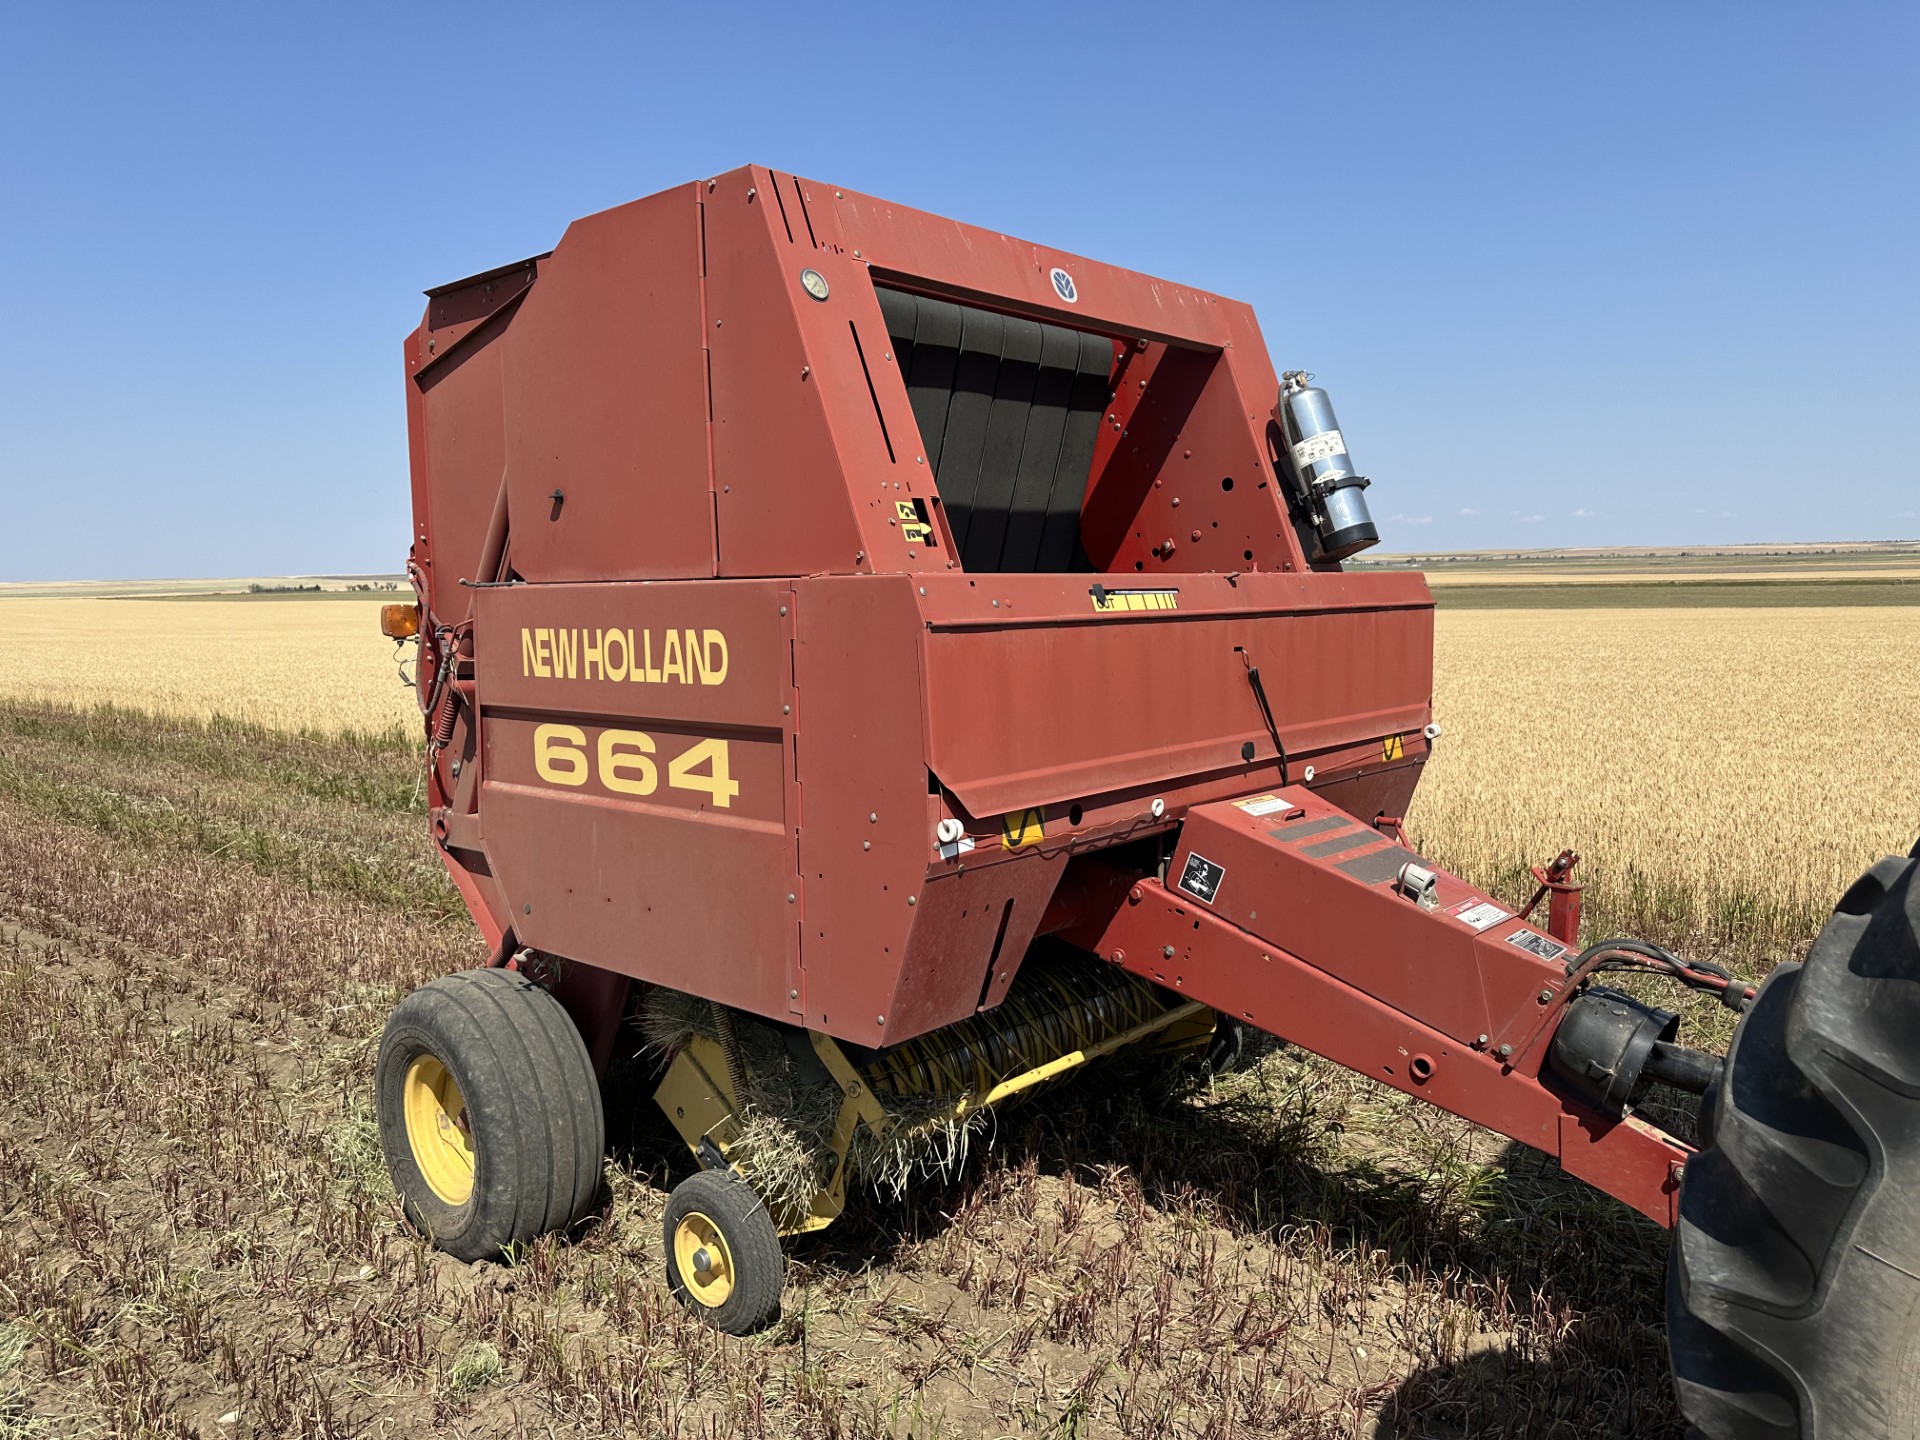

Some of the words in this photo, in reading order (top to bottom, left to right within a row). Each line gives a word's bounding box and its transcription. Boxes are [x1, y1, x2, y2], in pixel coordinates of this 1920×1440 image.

[521, 628, 578, 679] NEW
[582, 628, 729, 686] HOLLAND
[533, 723, 740, 808] 664
